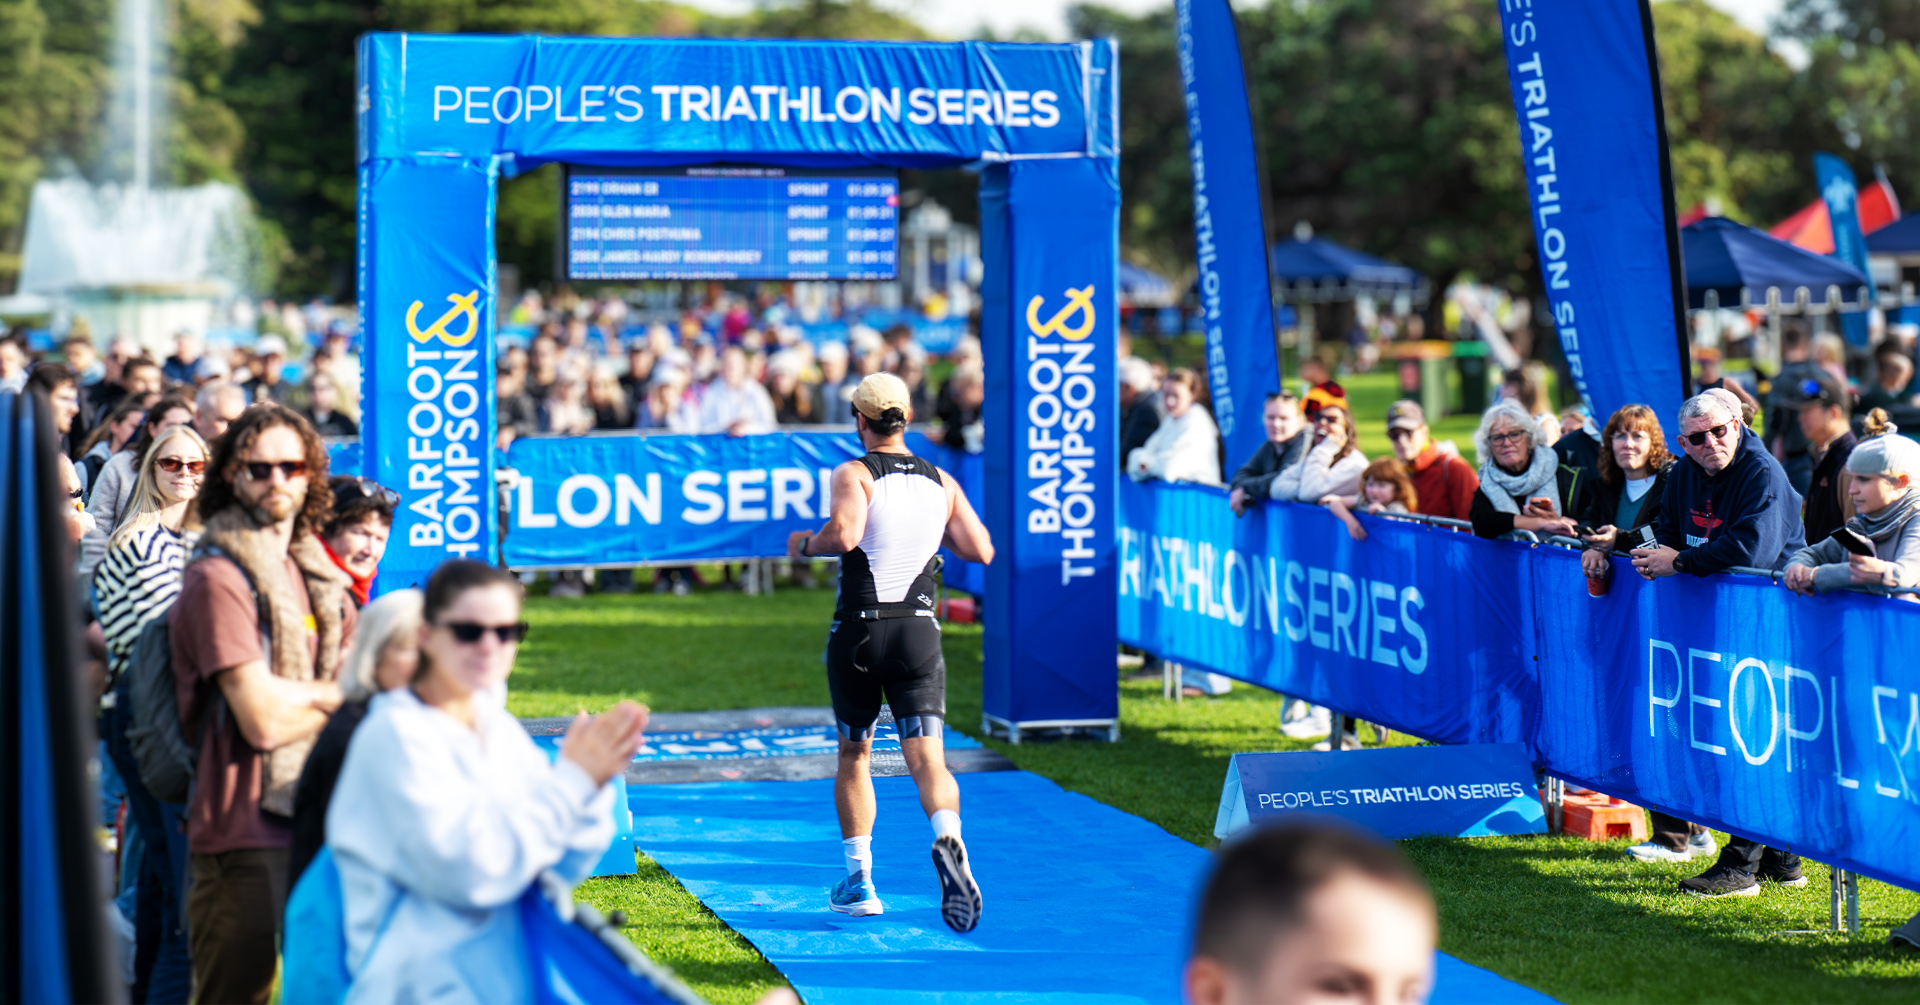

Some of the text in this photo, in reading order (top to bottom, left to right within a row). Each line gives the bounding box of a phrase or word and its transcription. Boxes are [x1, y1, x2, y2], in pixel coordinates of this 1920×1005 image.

[433, 84, 1060, 128] PEOPLE'S TRIATHLON SERIES
[1517, 51, 1571, 291] TRIATHLON
[1195, 139, 1222, 321] TRIATHLON
[407, 342, 444, 547] BARFOOT
[443, 349, 480, 559] HOMPSON
[1027, 335, 1062, 533] BARFOOT
[1061, 343, 1096, 586] THOMPSON
[1208, 325, 1236, 438] SERIES
[681, 467, 832, 525] SERI
[1116, 526, 1428, 675] RIATHLON SERIES
[1258, 782, 1524, 809] PEOPLE'S TRIATHLON SERIES
